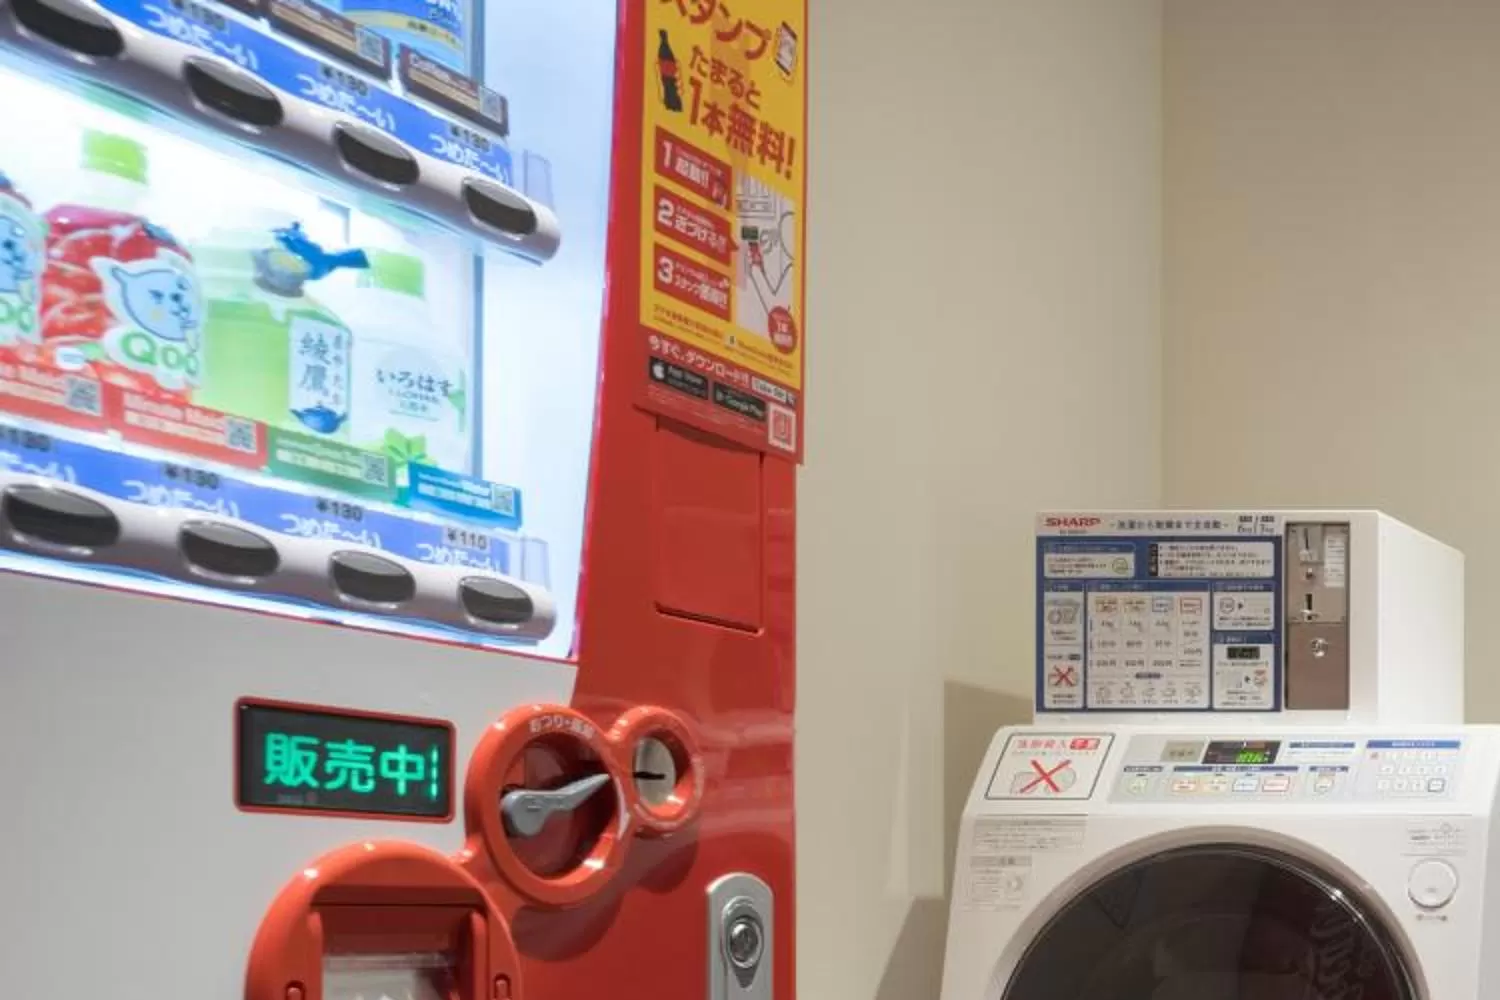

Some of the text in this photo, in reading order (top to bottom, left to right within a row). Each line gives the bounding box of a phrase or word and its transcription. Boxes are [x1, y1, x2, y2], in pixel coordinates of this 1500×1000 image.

[660, 0, 772, 60] タンプ
[689, 45, 762, 110] たまると
[119, 331, 198, 376] Qoo
[375, 368, 454, 397] いろはす
[1045, 517, 1101, 529] SHARP
